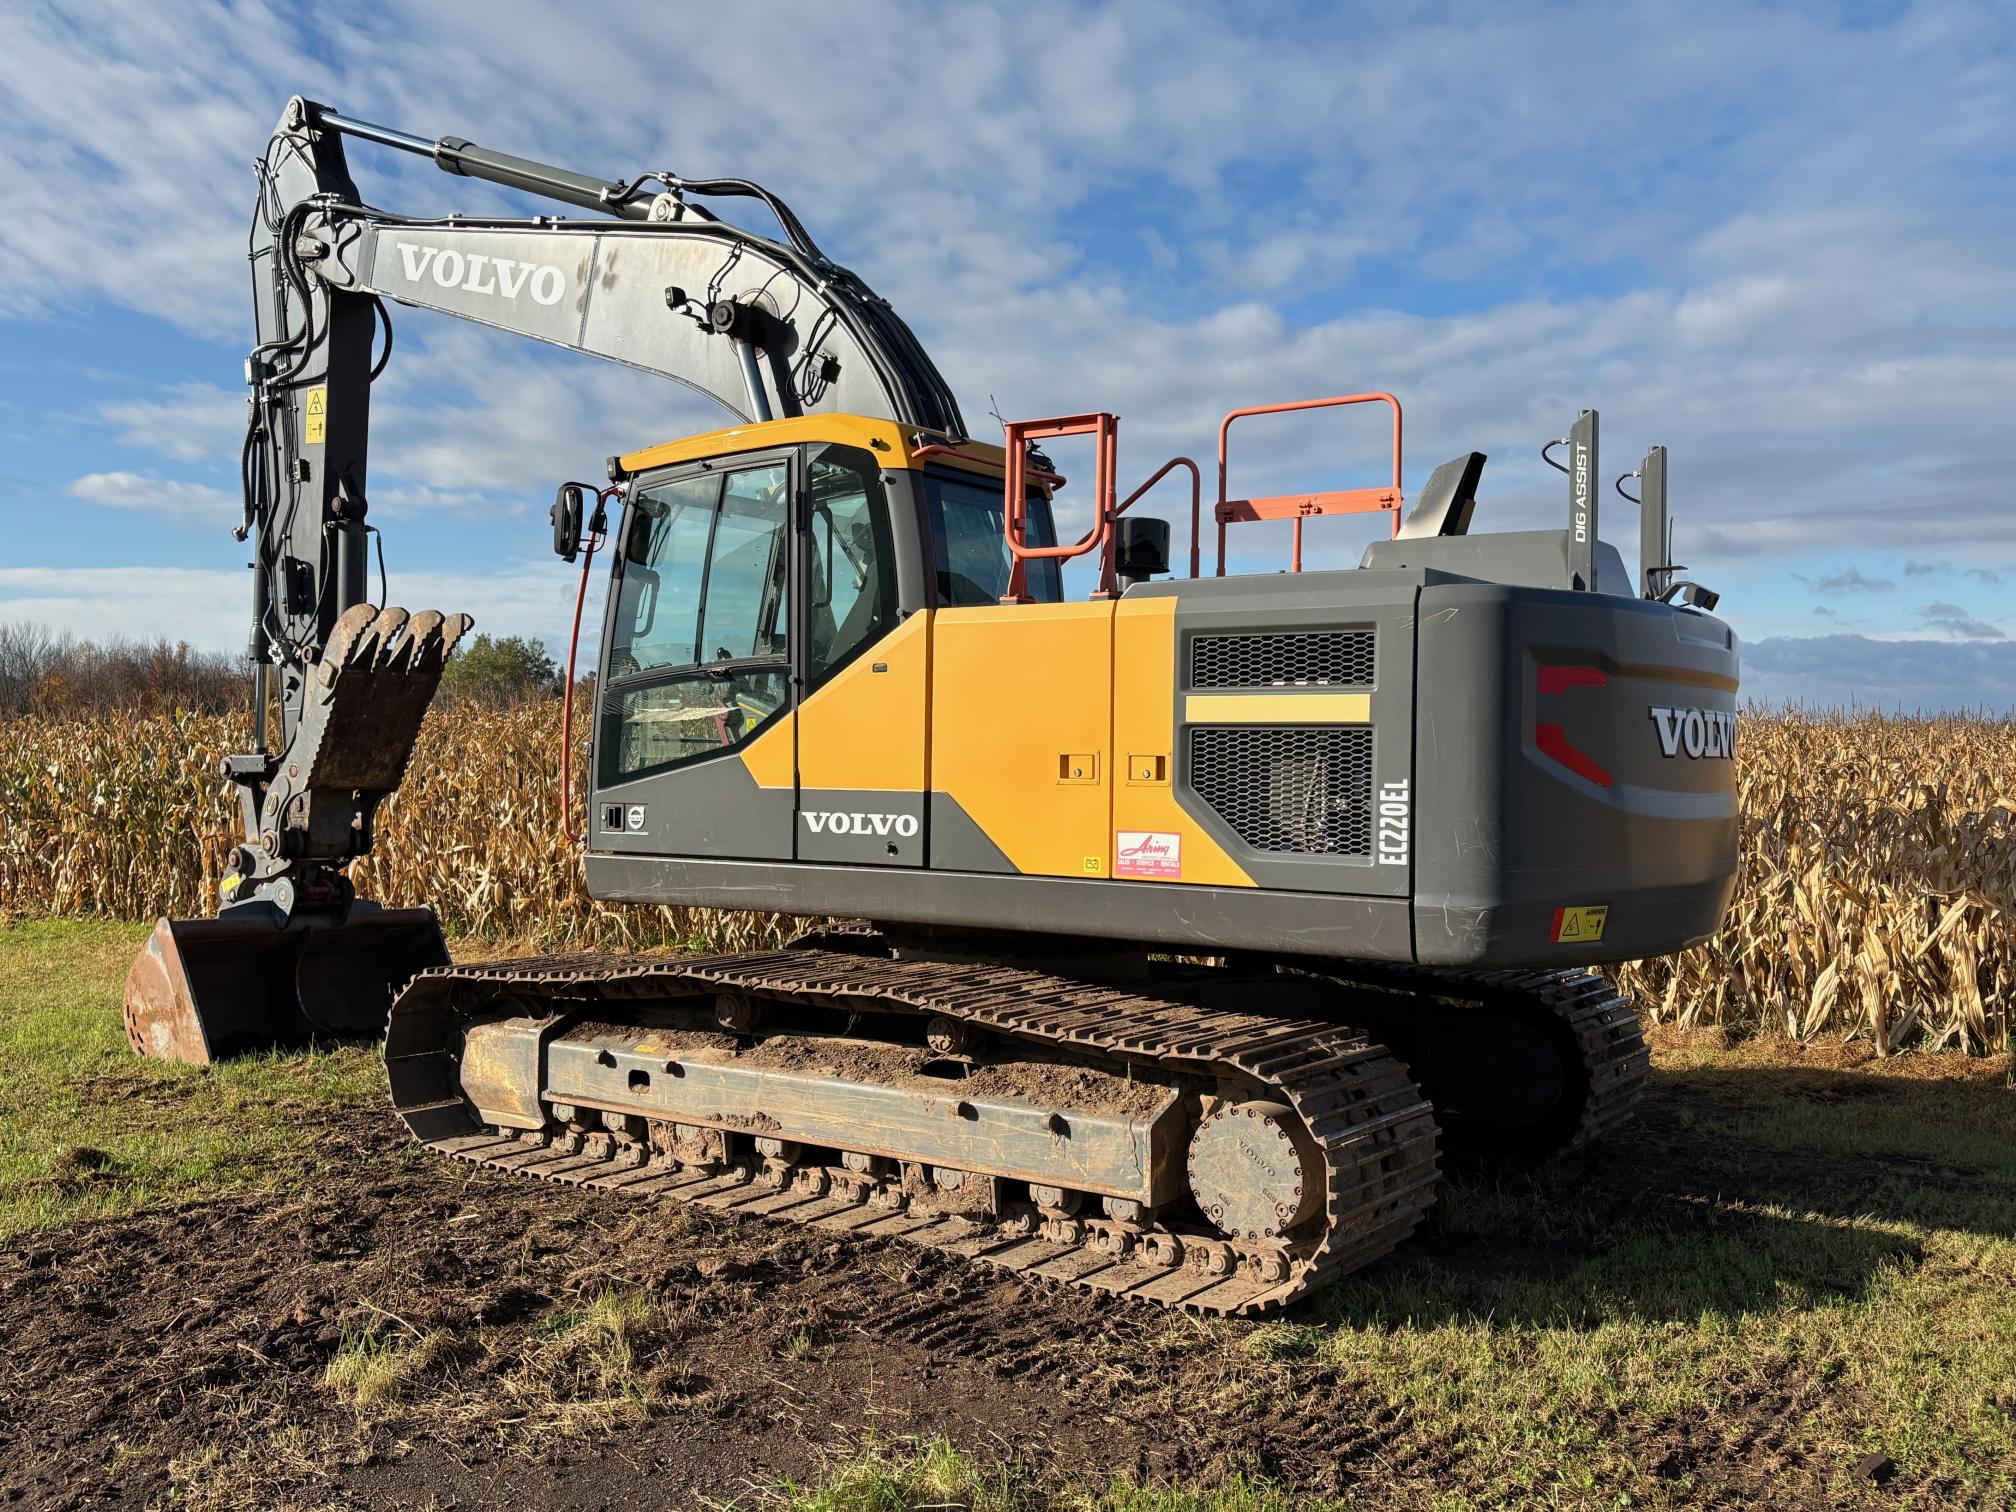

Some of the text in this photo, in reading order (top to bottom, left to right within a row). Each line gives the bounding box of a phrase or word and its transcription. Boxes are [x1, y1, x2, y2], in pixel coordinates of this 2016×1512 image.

[396, 242, 566, 306] VOLVO
[1575, 441, 1588, 543] DIG ASSIST
[801, 811, 919, 837] VOLVO
[1378, 778, 1409, 866] EC220EL
[1240, 1139, 1275, 1177] VOLVO
